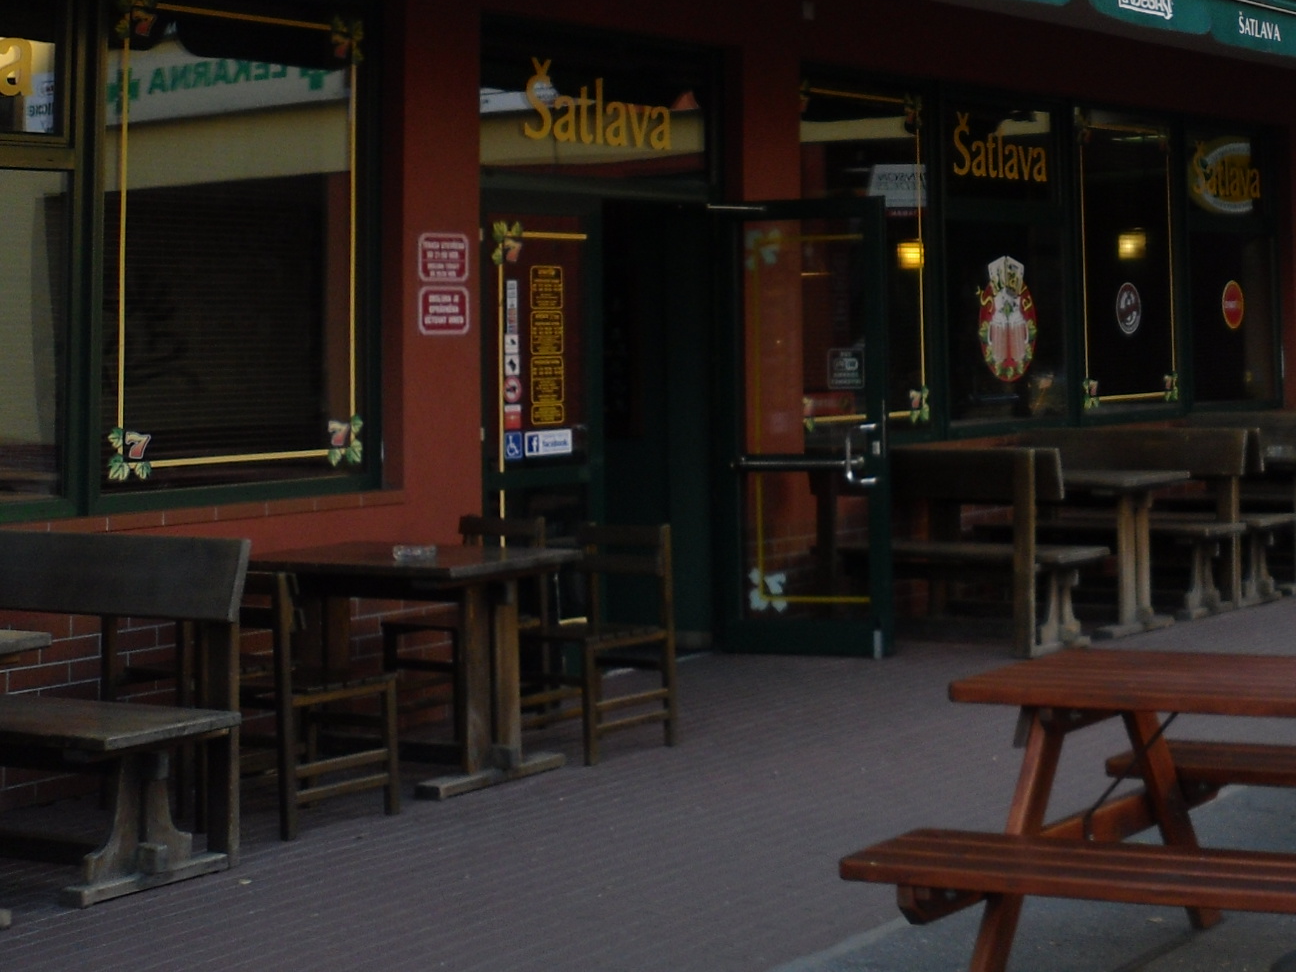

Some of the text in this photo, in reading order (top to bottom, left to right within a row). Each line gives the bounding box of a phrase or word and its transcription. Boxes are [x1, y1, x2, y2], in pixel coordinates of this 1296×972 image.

[1238, 11, 1282, 42] ŠATLAVA
[523, 55, 672, 150] Šatlava
[952, 110, 1048, 183] Šatlava
